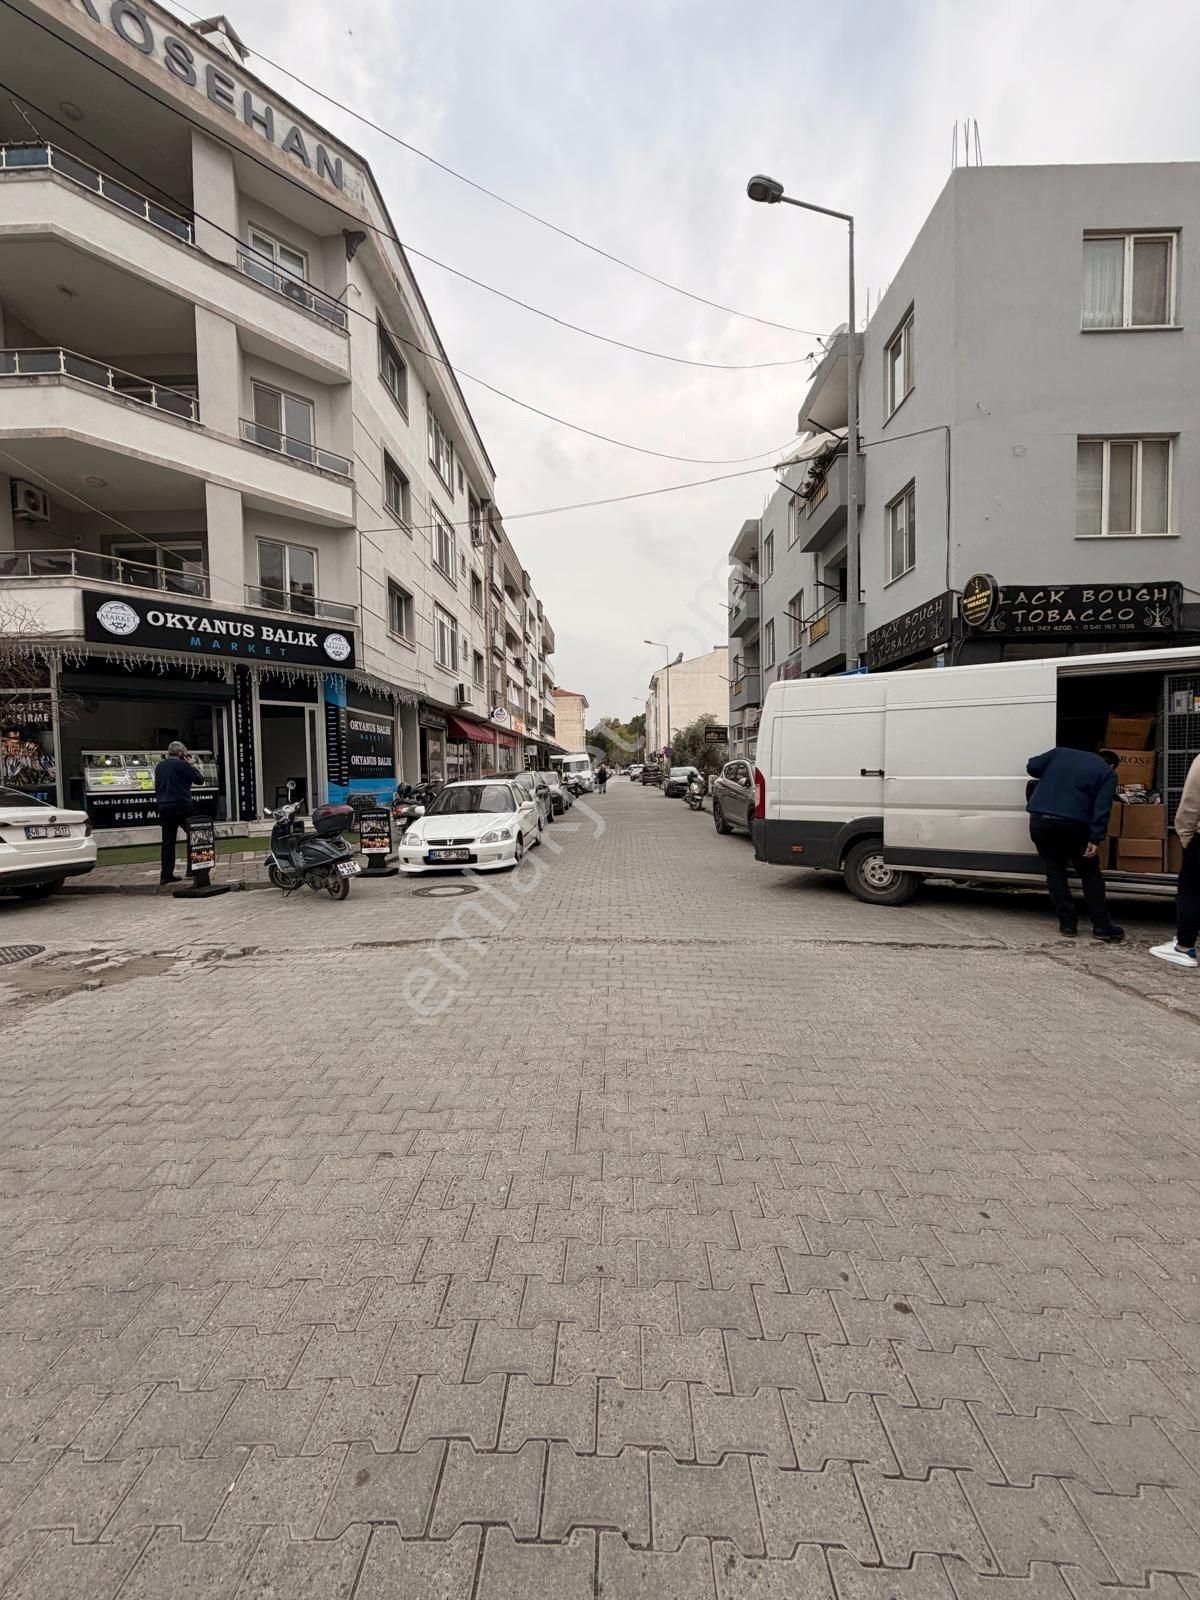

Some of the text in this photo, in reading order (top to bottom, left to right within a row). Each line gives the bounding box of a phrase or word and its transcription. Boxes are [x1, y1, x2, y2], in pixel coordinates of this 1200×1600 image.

[998, 587, 1168, 606] LACK BOUGH
[100, 612, 137, 624] MARKET
[871, 622, 899, 646] BLACK
[905, 599, 943, 629] BOUGH
[1012, 607, 1135, 624] TOBACCO
[146, 610, 318, 648] OKYANUS BALIK
[190, 636, 288, 656] MARKET
[880, 626, 926, 654] TOBACCO
[350, 720, 391, 736] OKYANUS BALIK
[351, 755, 392, 767] OKYANUS BALIK
[123, 797, 157, 805] IZGARA-TA
[114, 811, 143, 821] FISH
